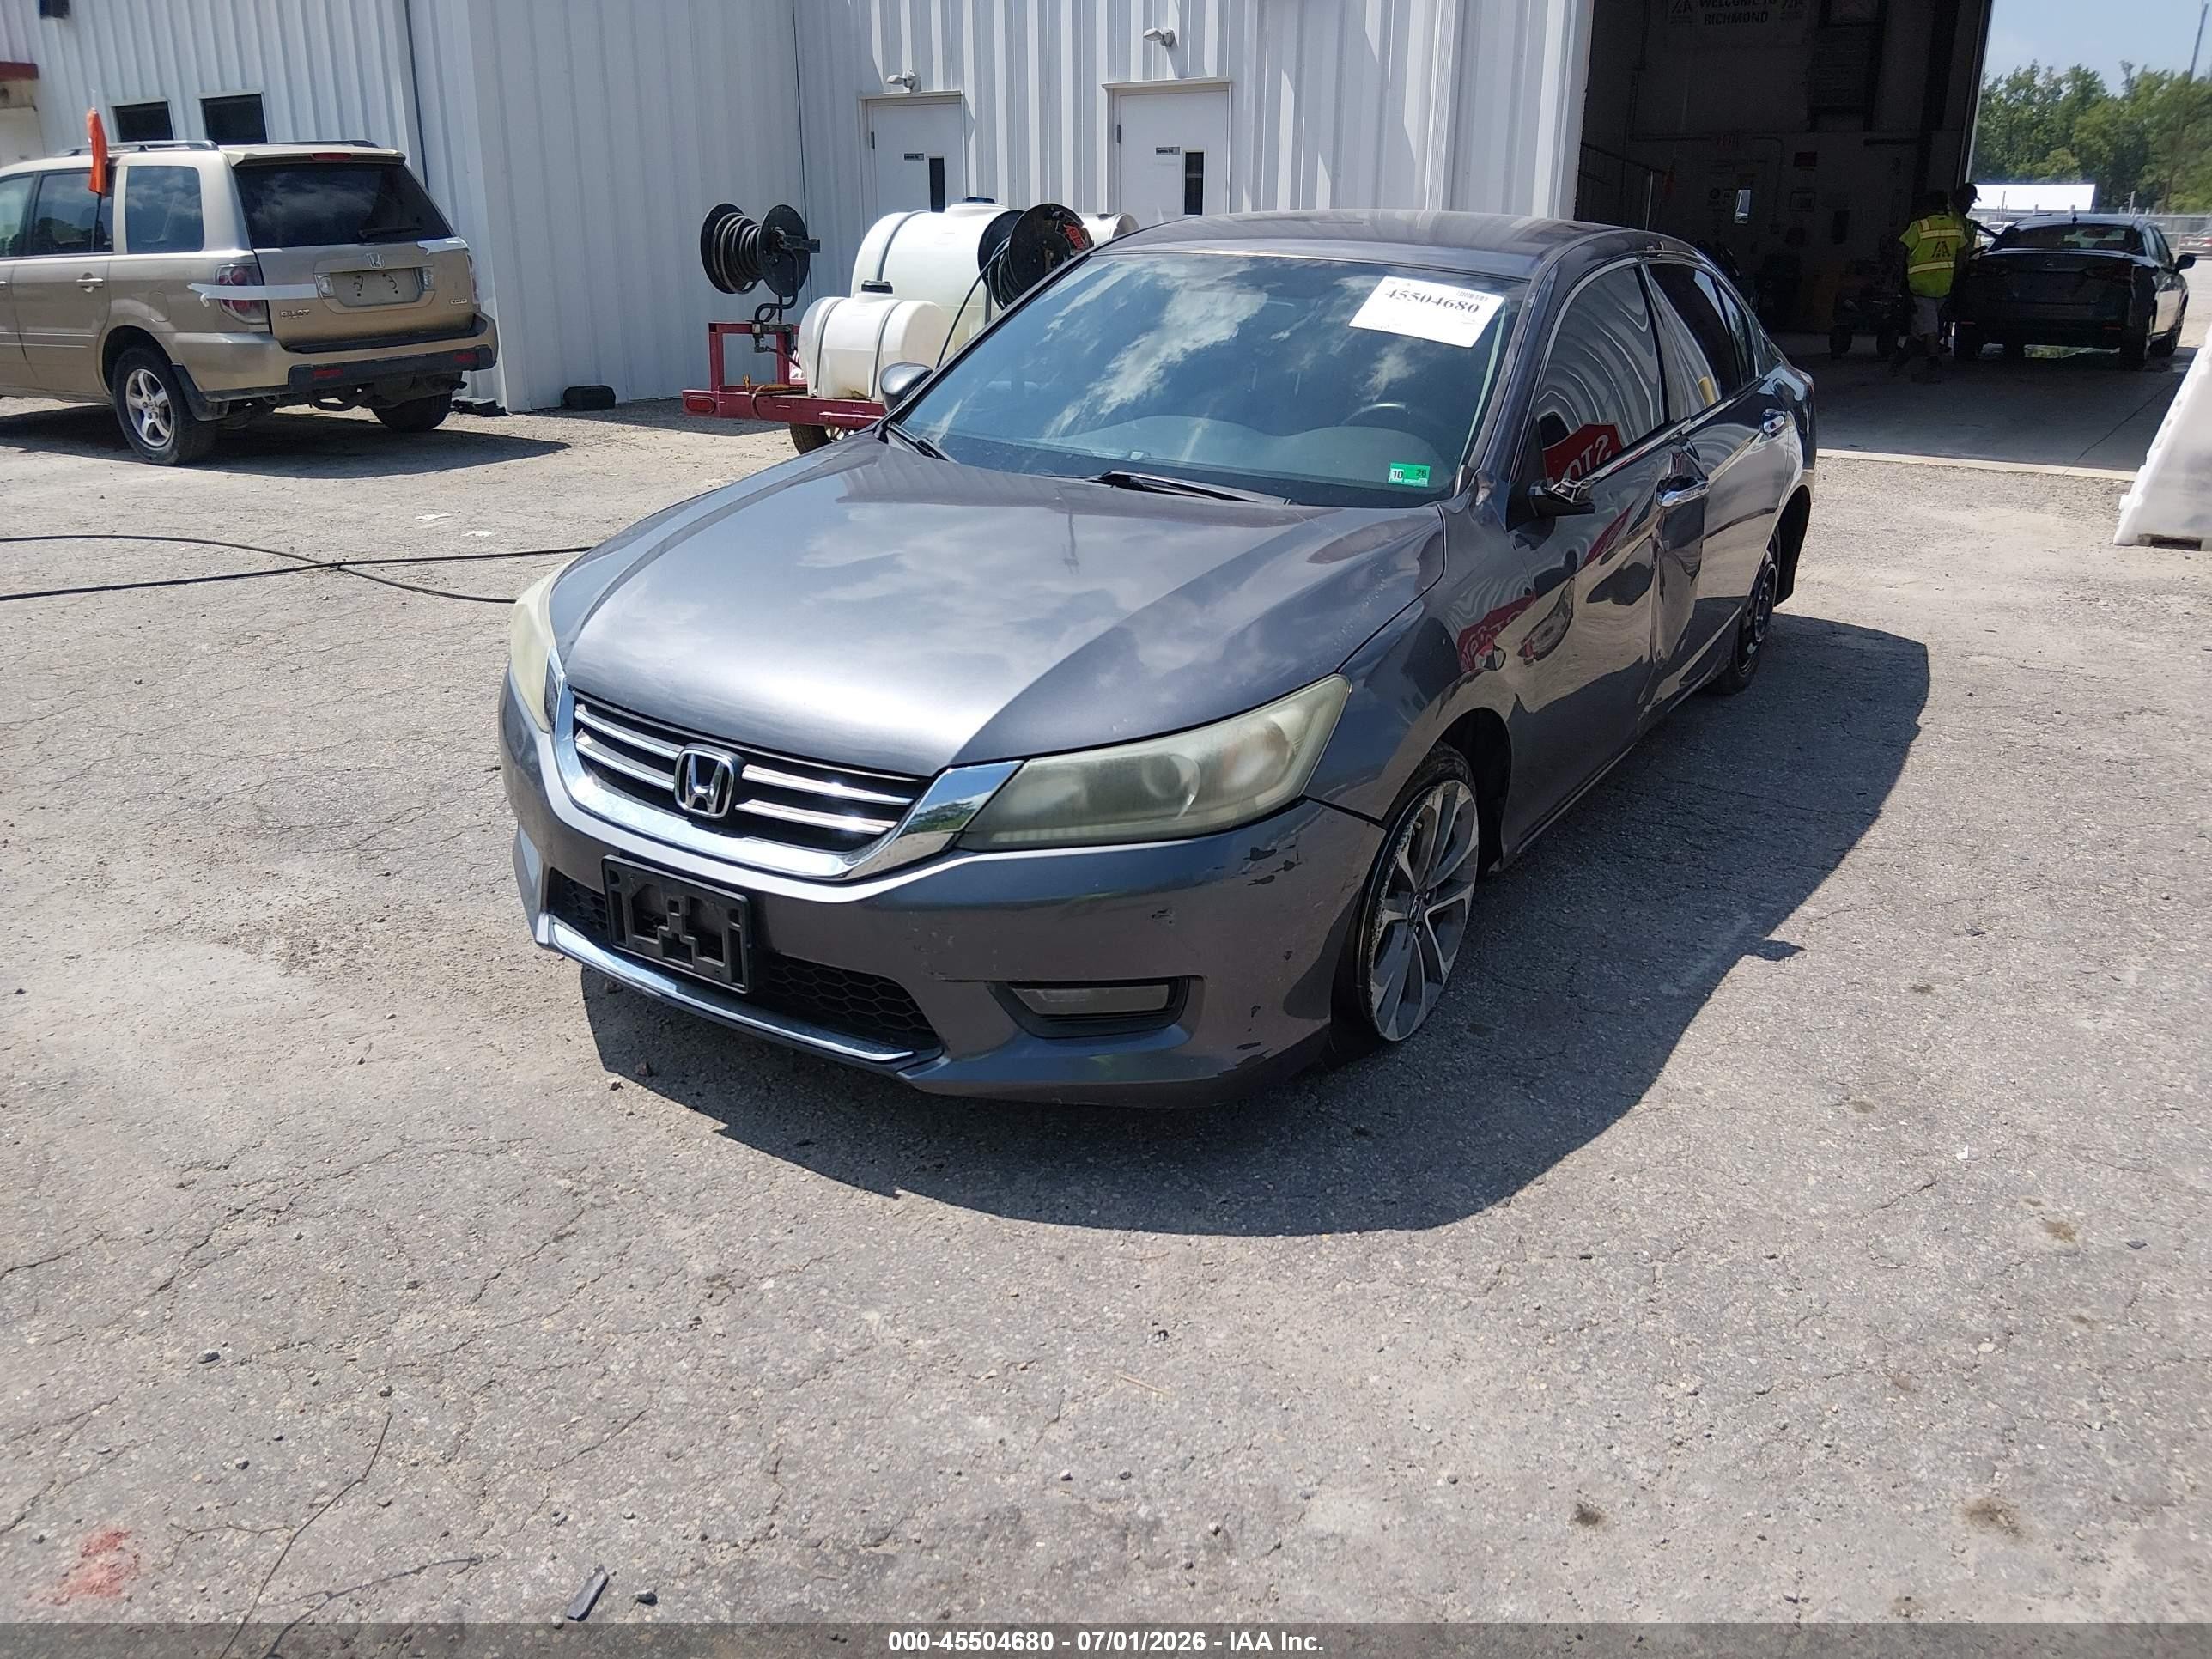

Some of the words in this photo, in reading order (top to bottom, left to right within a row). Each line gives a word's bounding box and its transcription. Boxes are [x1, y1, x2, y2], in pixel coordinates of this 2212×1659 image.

[1704, 11, 1769, 26] RICHMOND
[1385, 289, 1480, 313] 45504680
[1393, 470, 1404, 479] 10
